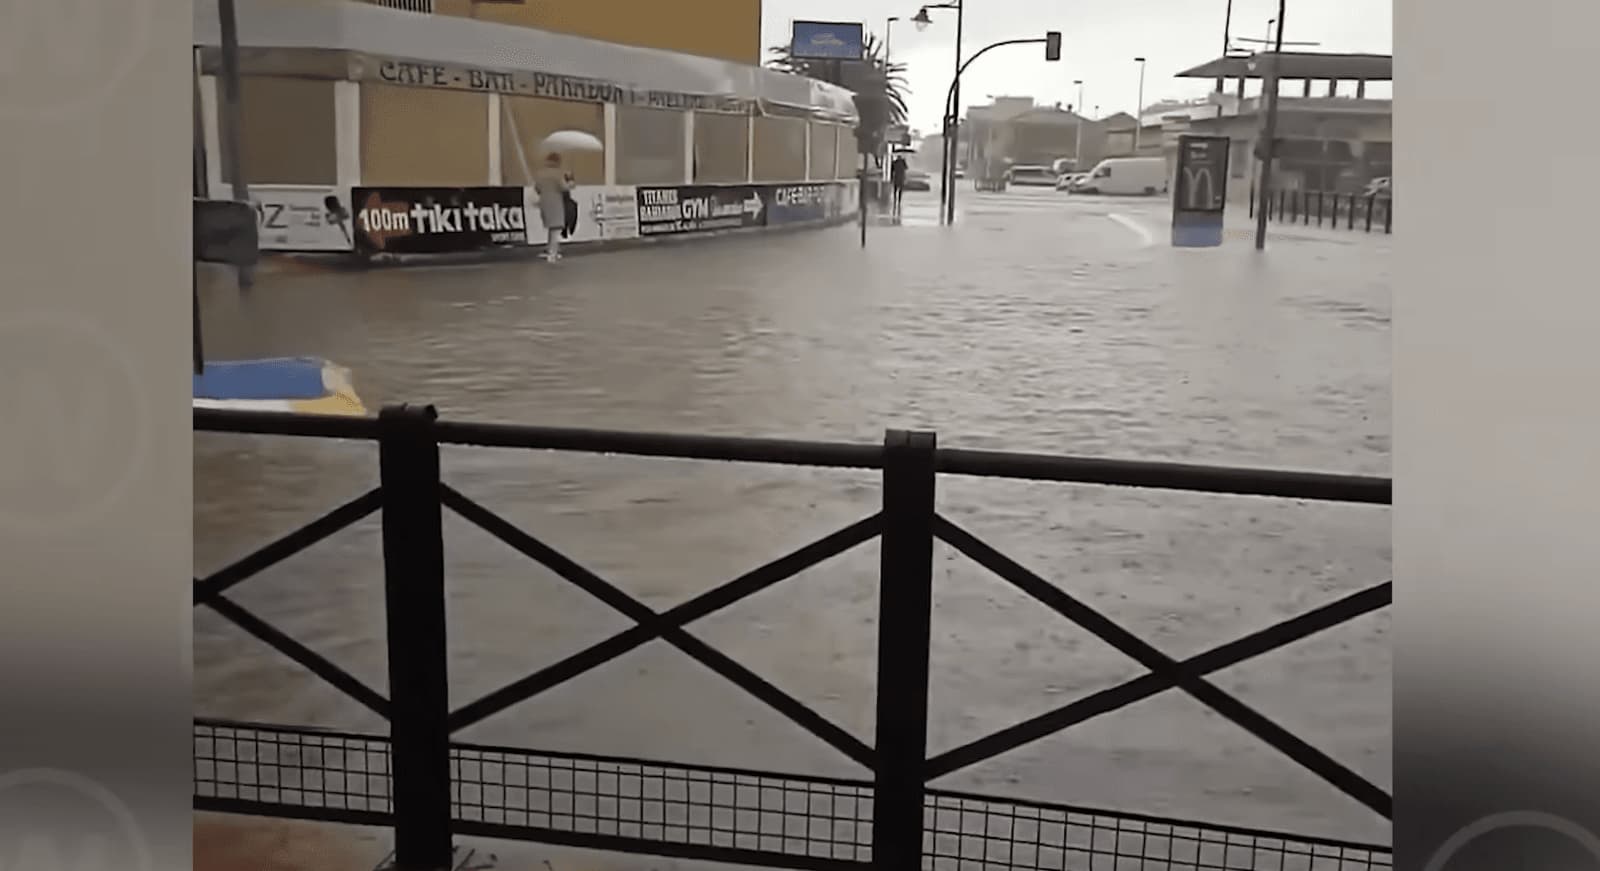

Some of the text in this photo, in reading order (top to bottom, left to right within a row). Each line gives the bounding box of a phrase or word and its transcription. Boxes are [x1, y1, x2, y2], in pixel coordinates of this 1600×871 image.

[465, 69, 515, 91] BAR
[682, 198, 709, 219] GYM
[358, 208, 409, 233] 100m
